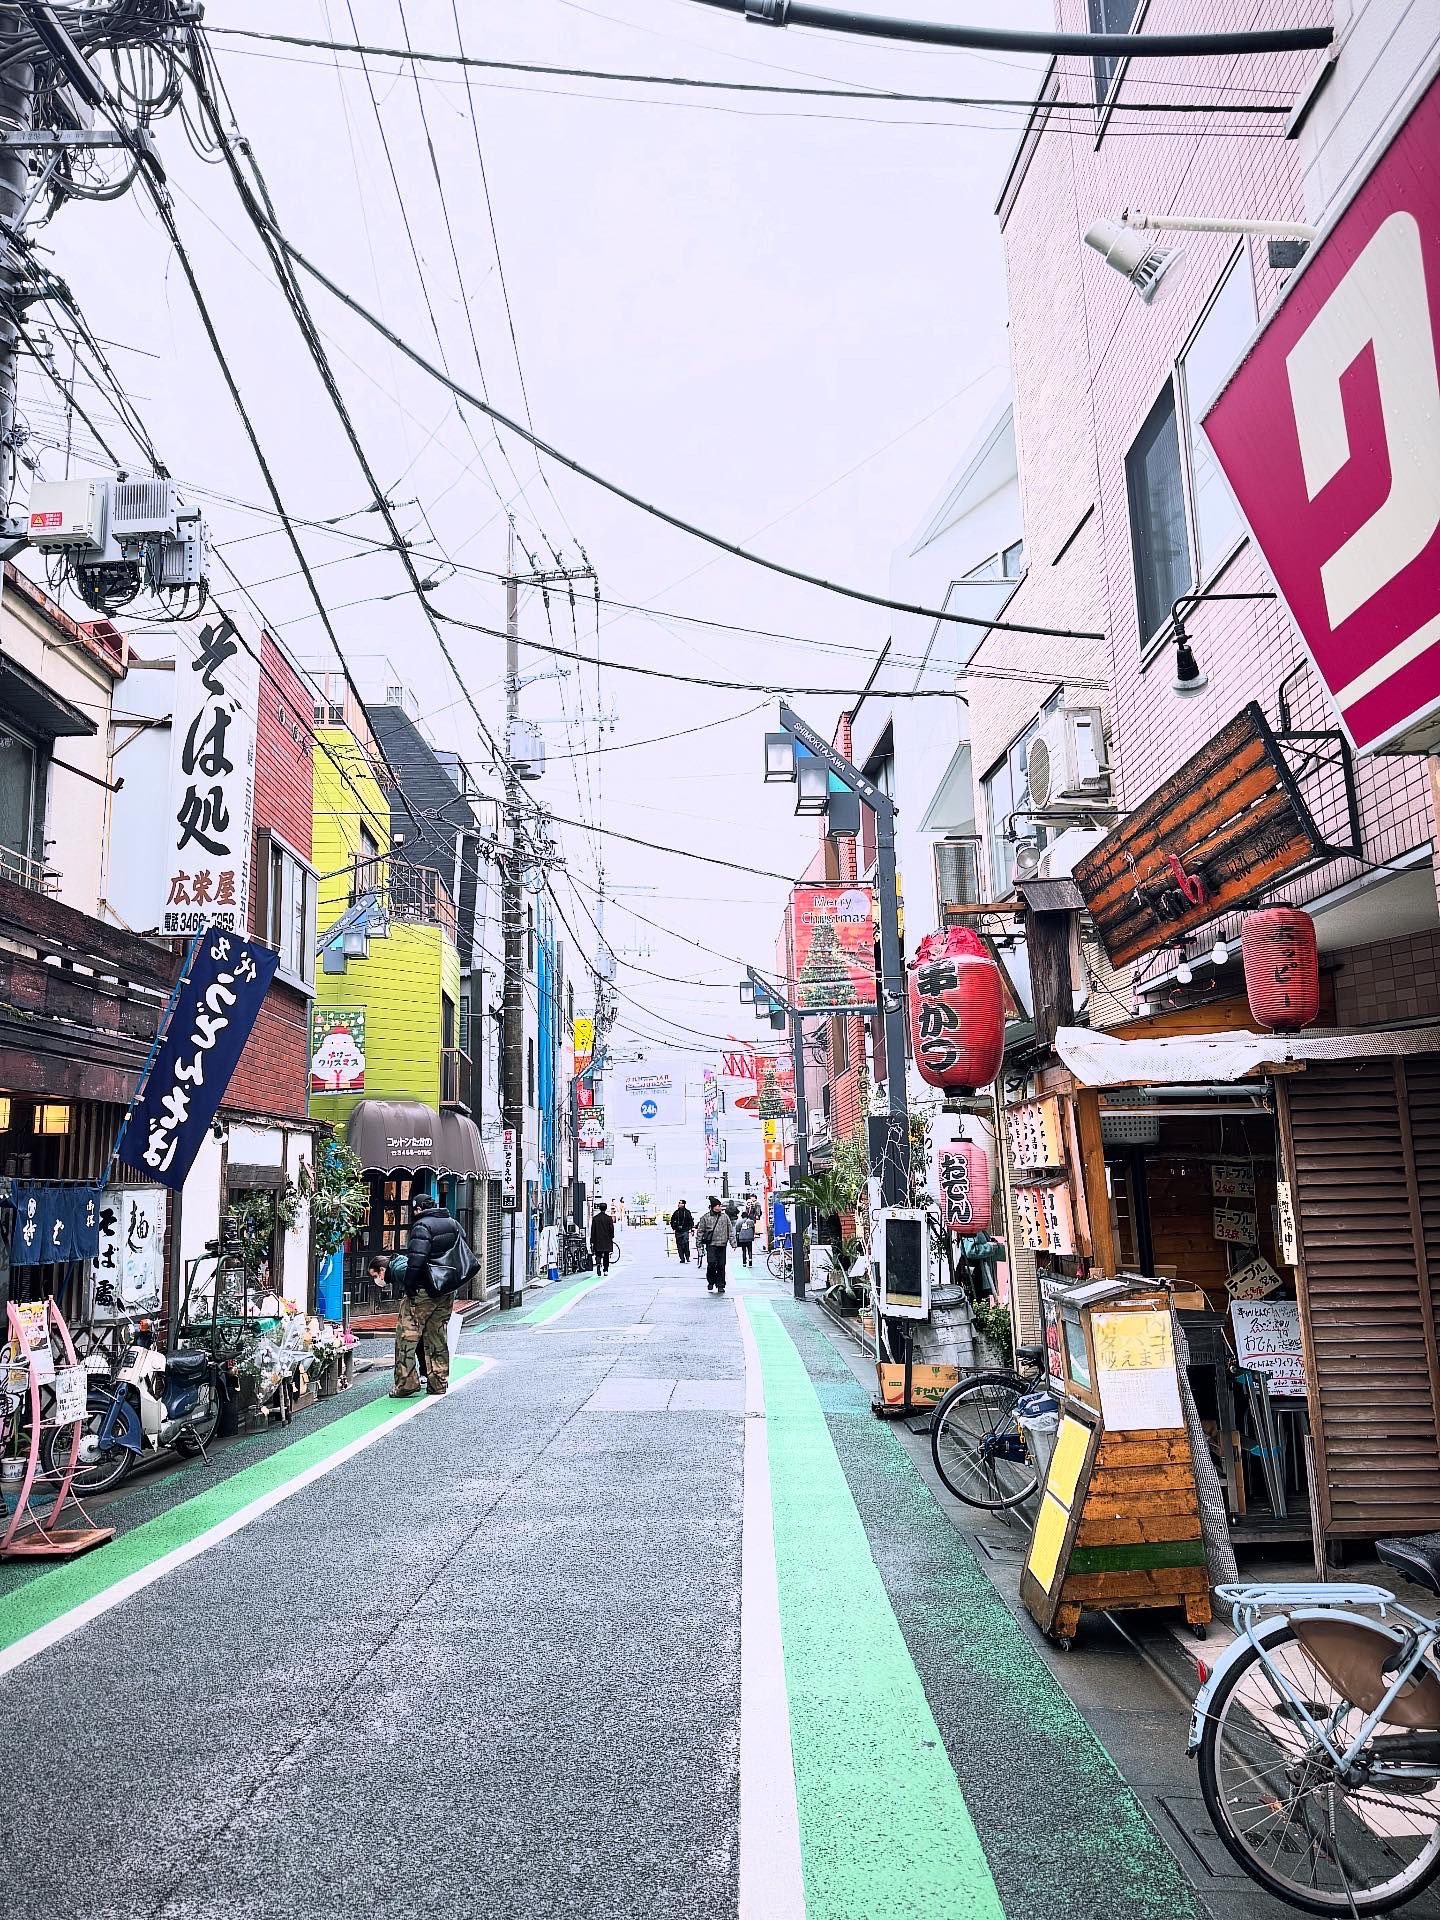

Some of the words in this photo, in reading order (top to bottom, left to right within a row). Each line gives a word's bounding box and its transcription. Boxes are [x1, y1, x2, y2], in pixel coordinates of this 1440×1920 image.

[177, 620, 241, 856] そば処
[794, 722, 847, 772] SHIMOKITAZAWA
[167, 869, 237, 907] 広栄屋
[813, 896, 852, 910] Merry
[802, 911, 867, 924] Christmas
[917, 961, 960, 1072] 串かつ
[319, 1058, 359, 1068] クリスマス
[941, 1153, 973, 1224] おでん
[1215, 1209, 1253, 1226] テーブル
[1226, 1263, 1268, 1293] テーブル
[1243, 1335, 1276, 1353] おでん
